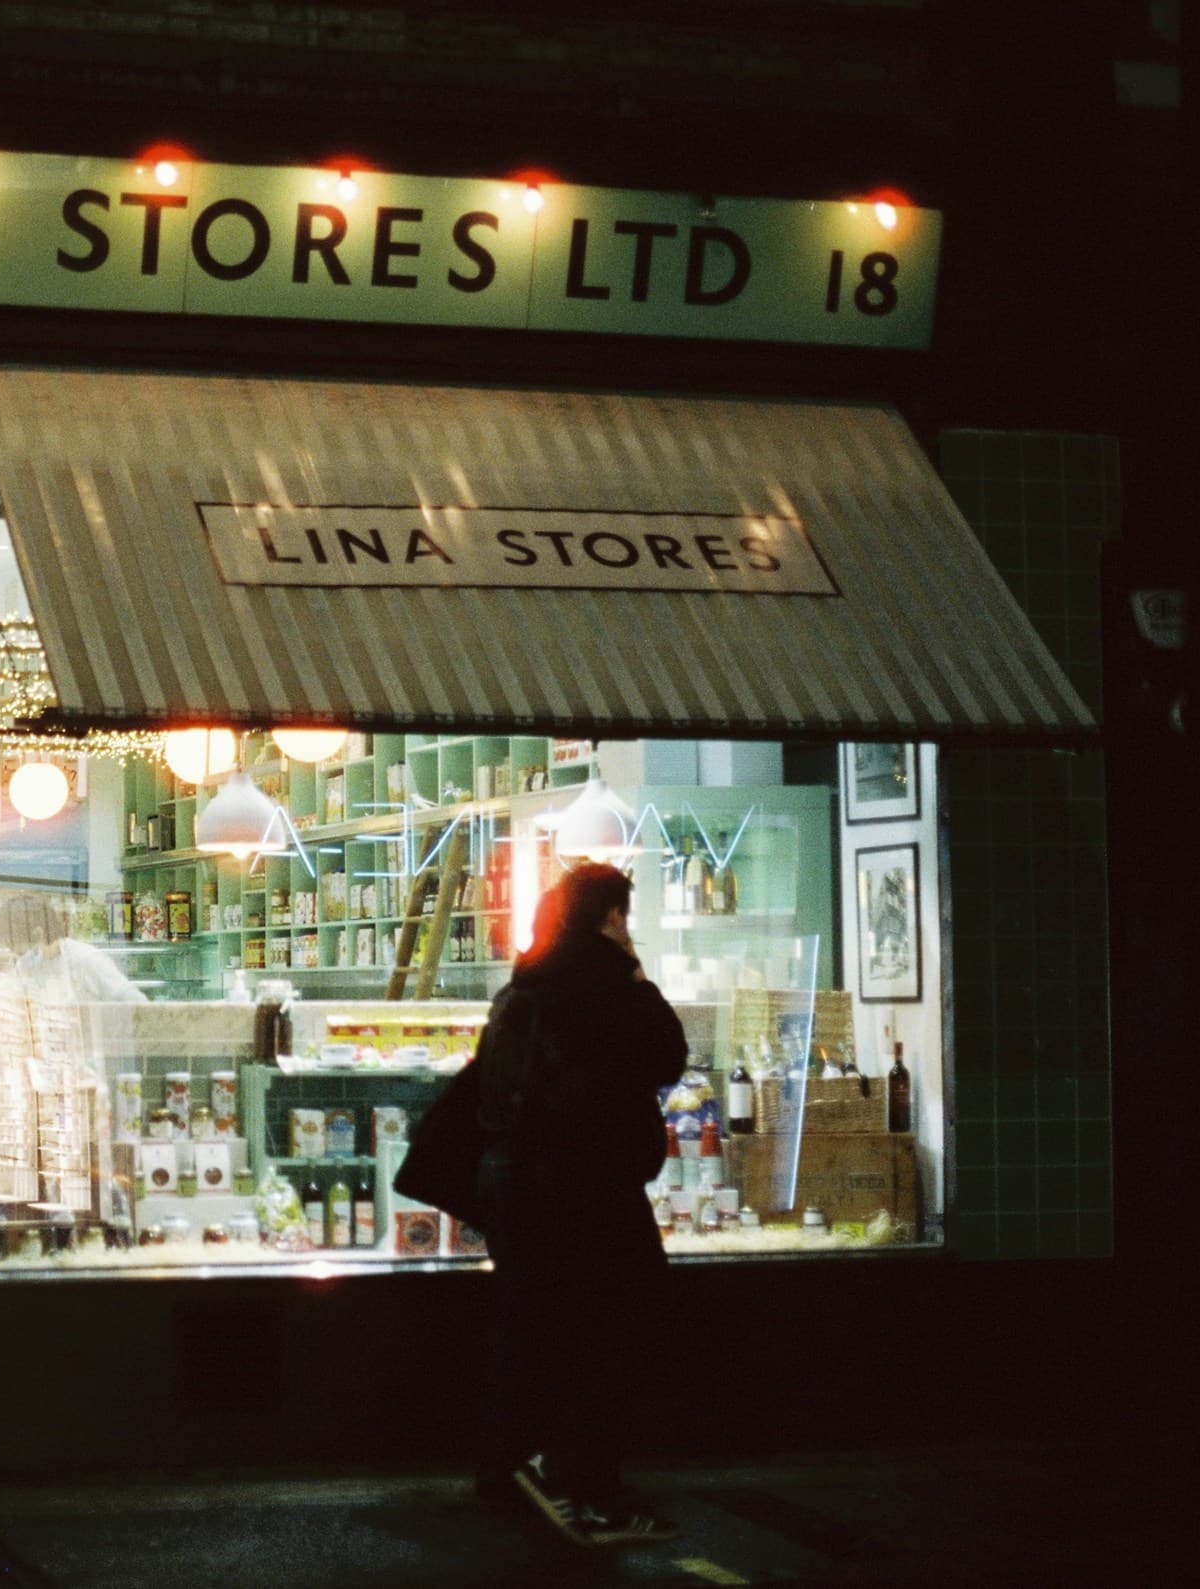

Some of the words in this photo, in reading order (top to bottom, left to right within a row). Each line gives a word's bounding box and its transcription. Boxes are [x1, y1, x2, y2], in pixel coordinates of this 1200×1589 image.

[56, 188, 500, 293] STORES
[565, 217, 751, 306] LTD
[824, 249, 899, 316] 18
[257, 526, 455, 566] LINA
[496, 528, 782, 572] STORES
